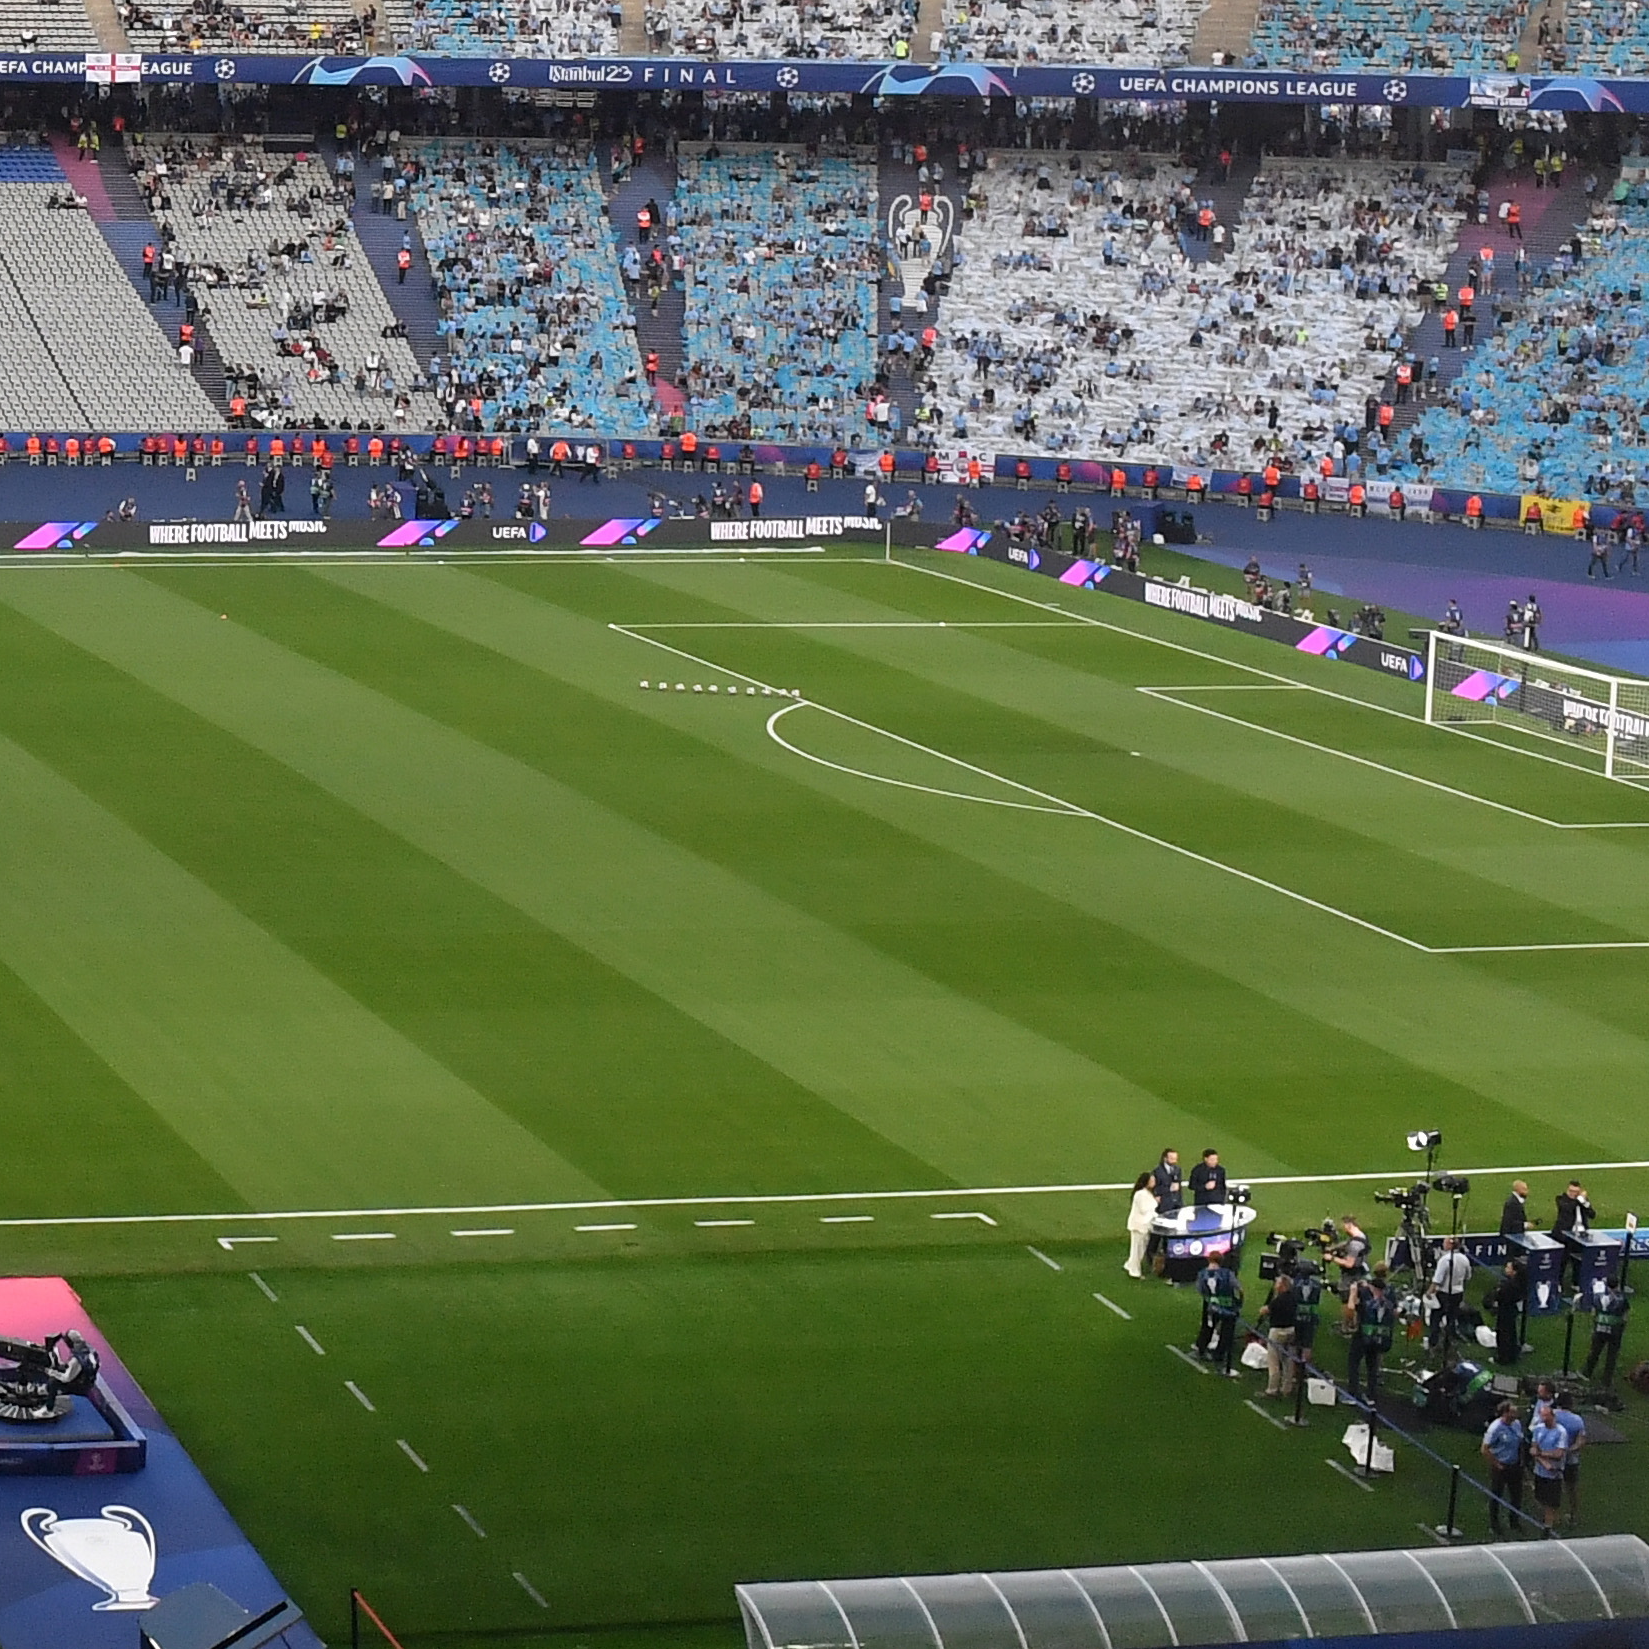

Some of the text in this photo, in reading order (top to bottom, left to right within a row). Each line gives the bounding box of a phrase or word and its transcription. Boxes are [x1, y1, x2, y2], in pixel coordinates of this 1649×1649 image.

[33, 61, 86, 74] CHAMP
[141, 62, 192, 74] EAGUE
[645, 68, 735, 83] FINAL
[1120, 78, 1356, 96] UEFA CHAMPIONS LEAGUE
[150, 525, 189, 543] WHERE
[191, 524, 248, 542] FOOTBALL
[249, 520, 287, 539] MEETS
[493, 527, 526, 538] UEFA
[711, 522, 749, 540] WHERE
[750, 520, 804, 538] FOOTBALL
[806, 517, 842, 534] MEETS
[1008, 547, 1028, 564] UEFA
[1381, 652, 1408, 673] UEFA
[1475, 1244, 1508, 1257] FIN
